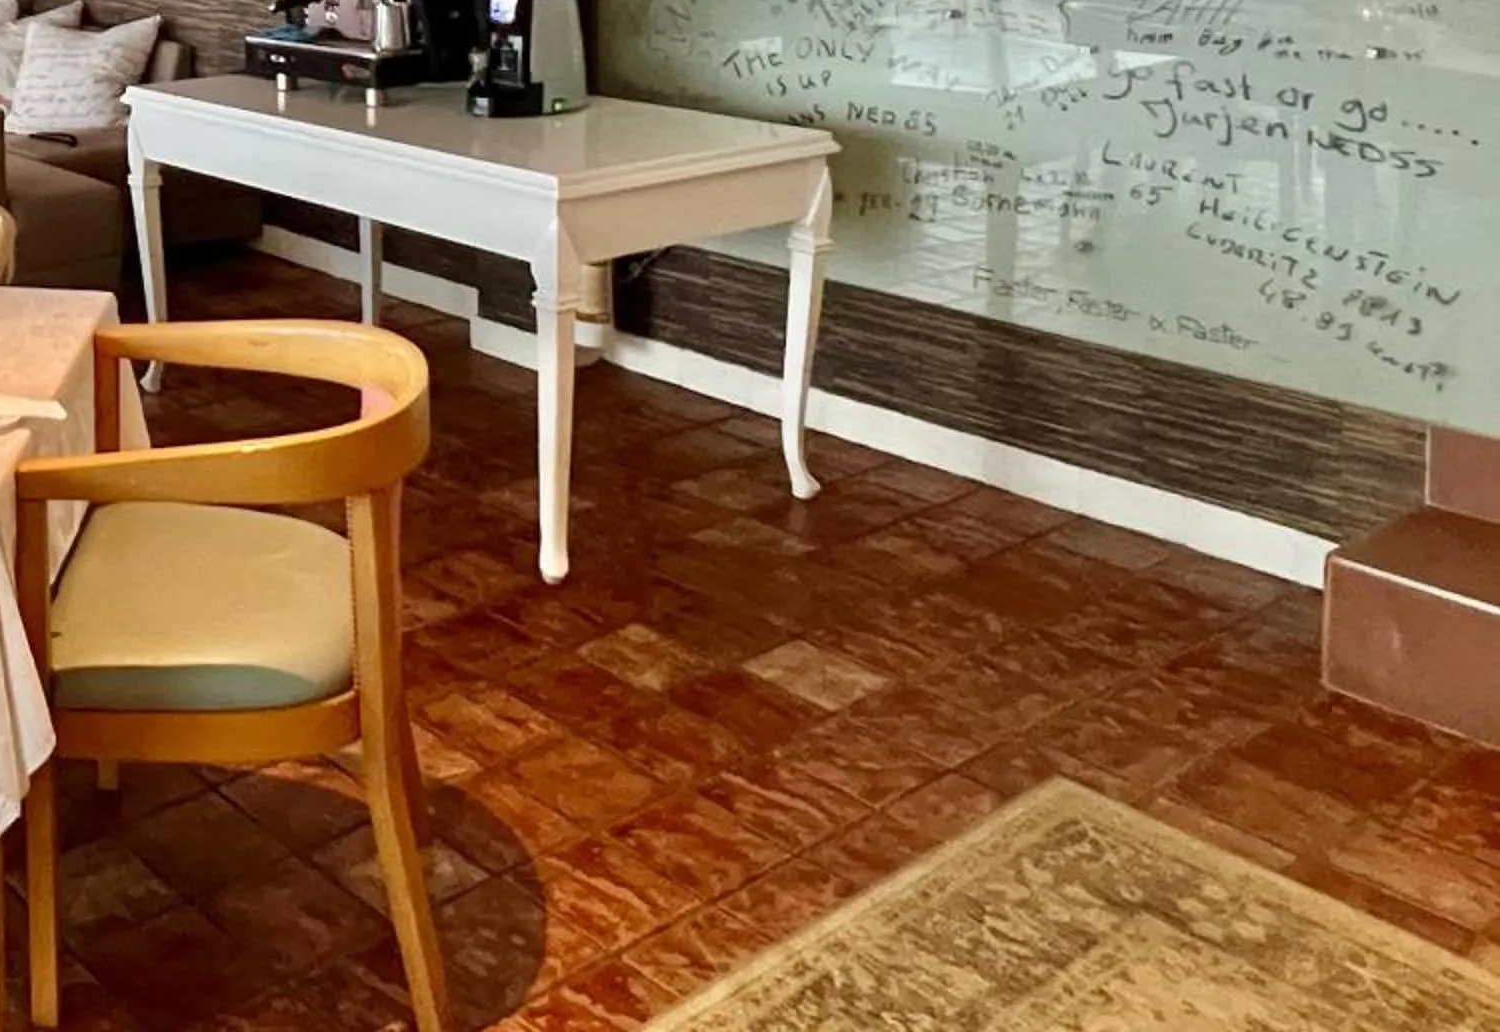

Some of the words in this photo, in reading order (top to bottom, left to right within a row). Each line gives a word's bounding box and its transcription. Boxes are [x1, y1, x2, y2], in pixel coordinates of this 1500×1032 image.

[722, 49, 784, 80] THE
[796, 36, 876, 64] ONLY
[765, 78, 788, 97] IS
[1103, 65, 1153, 101] go
[1164, 59, 1252, 102] fast
[1275, 87, 1315, 111] or
